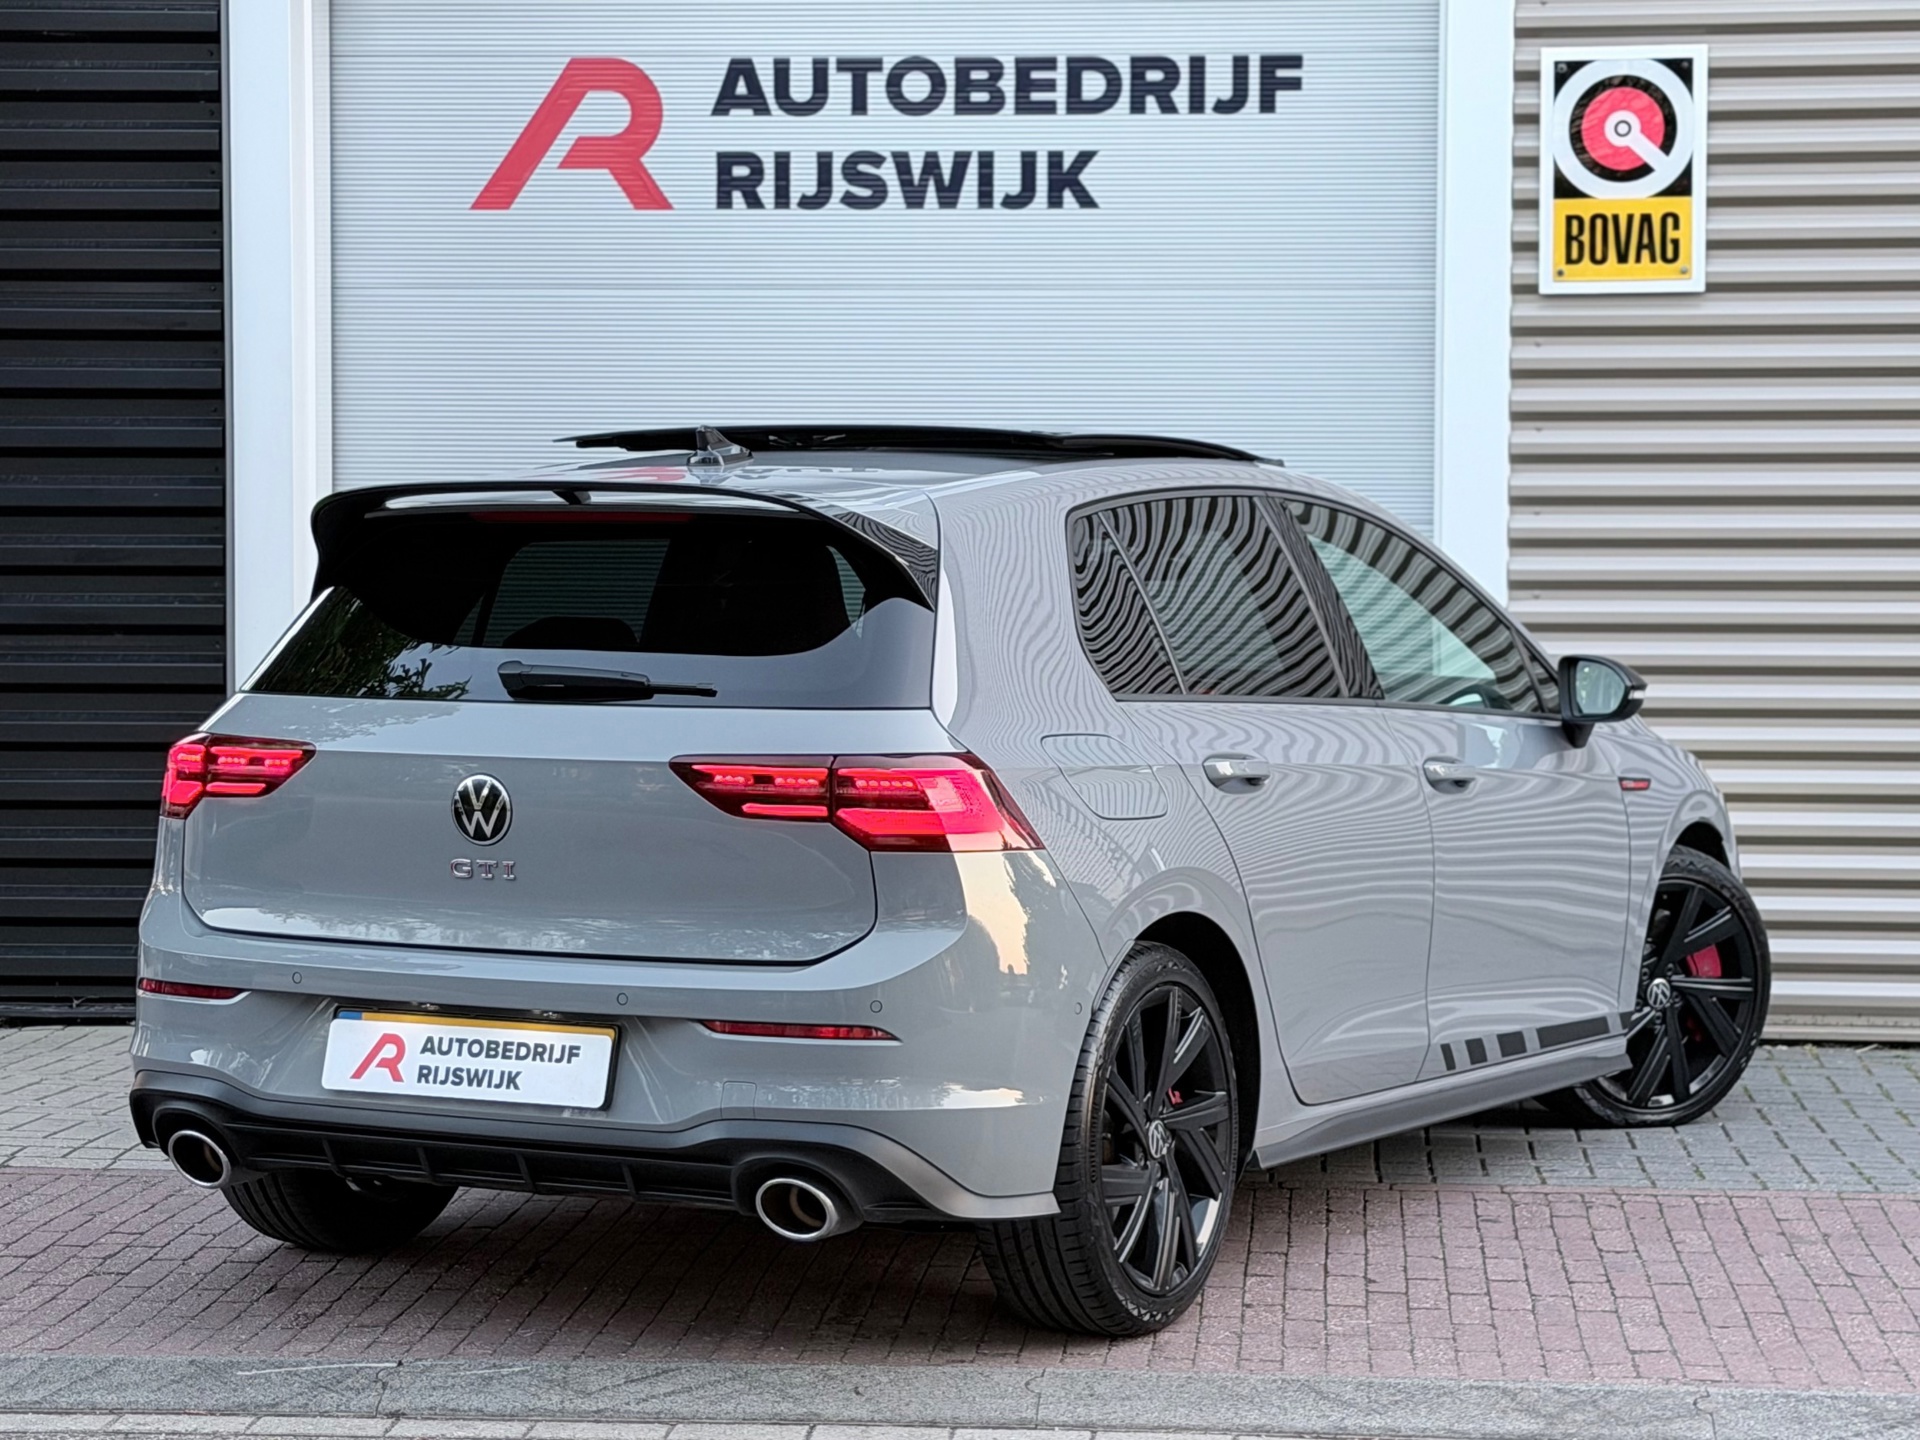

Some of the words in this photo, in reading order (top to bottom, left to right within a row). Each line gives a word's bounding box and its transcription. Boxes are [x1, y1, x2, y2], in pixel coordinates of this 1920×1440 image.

[711, 55, 1303, 117] AUTOBEDRIJF
[716, 150, 1100, 210] RIJSWIJK
[1565, 212, 1681, 265] BOVAG
[450, 858, 516, 880] GTI
[420, 1036, 582, 1064] AUTOBEDRIJF
[417, 1065, 522, 1091] RIJSWIJK
